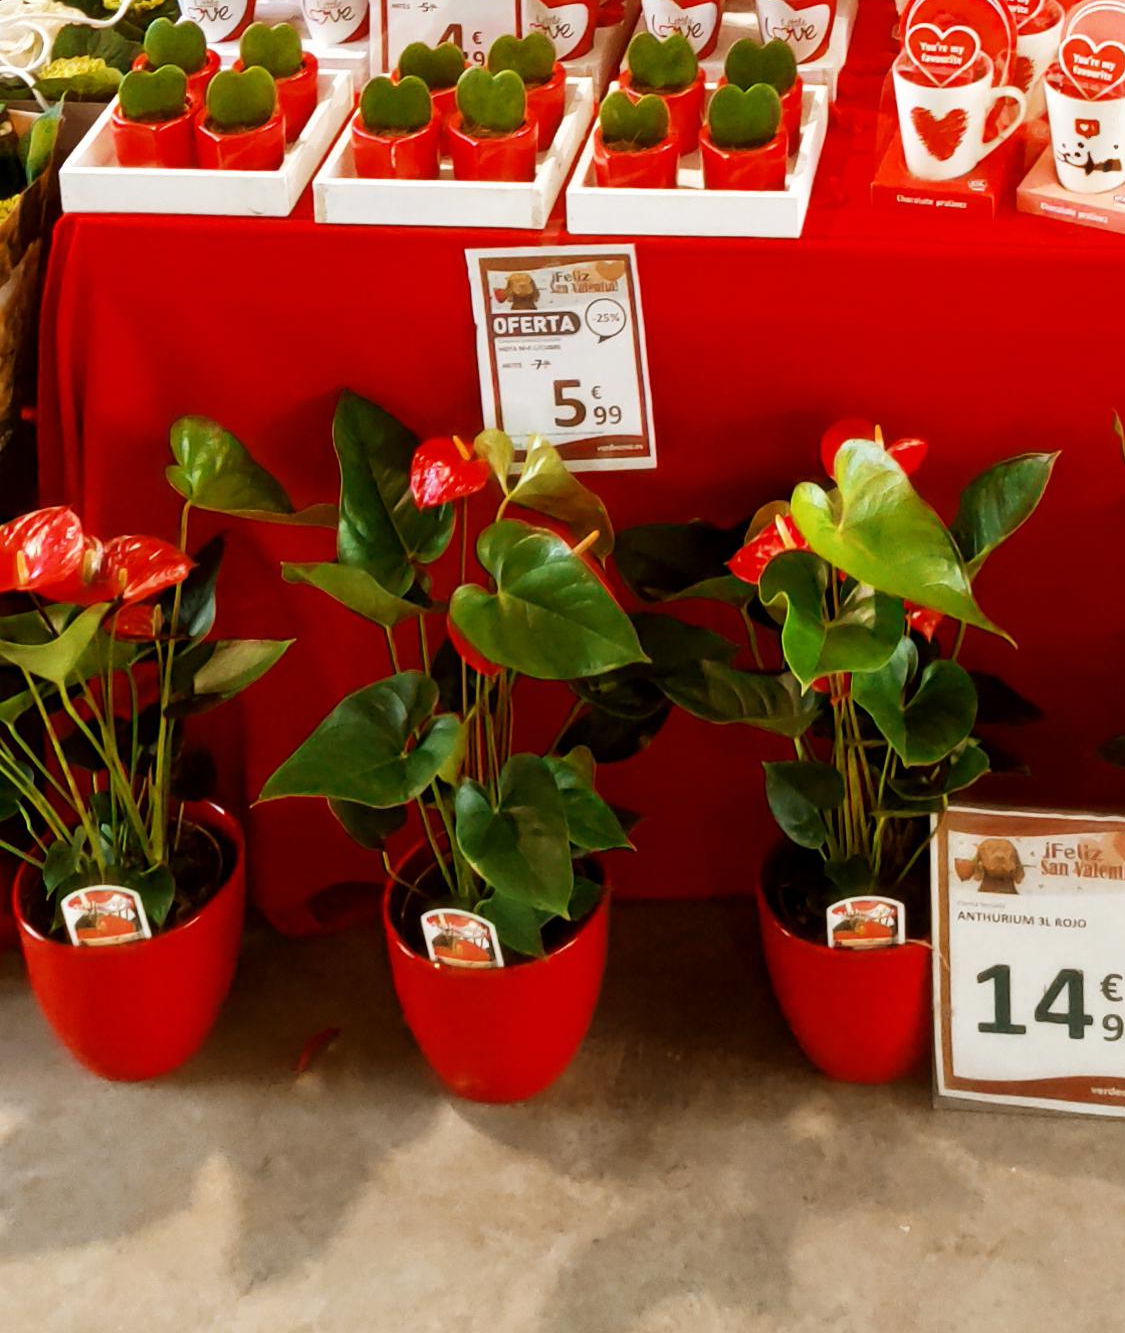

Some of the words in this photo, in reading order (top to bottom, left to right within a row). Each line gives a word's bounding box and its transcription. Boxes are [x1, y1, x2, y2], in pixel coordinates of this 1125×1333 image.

[950, 45, 965, 56] my
[1101, 59, 1117, 72] my
[493, 315, 576, 335] OFERTA
[592, 313, 620, 323] -25%
[591, 385, 602, 400] €
[553, 379, 587, 428] 5
[593, 405, 622, 425] 99
[1043, 841, 1103, 861] ¡Feliz
[1040, 859, 1069, 877] San
[957, 910, 1035, 926] ANTHURIUM
[1038, 916, 1052, 928] 3L
[1054, 917, 1087, 929] ROJO
[976, 964, 1094, 1040] 14
[1100, 973, 1124, 1002] €
